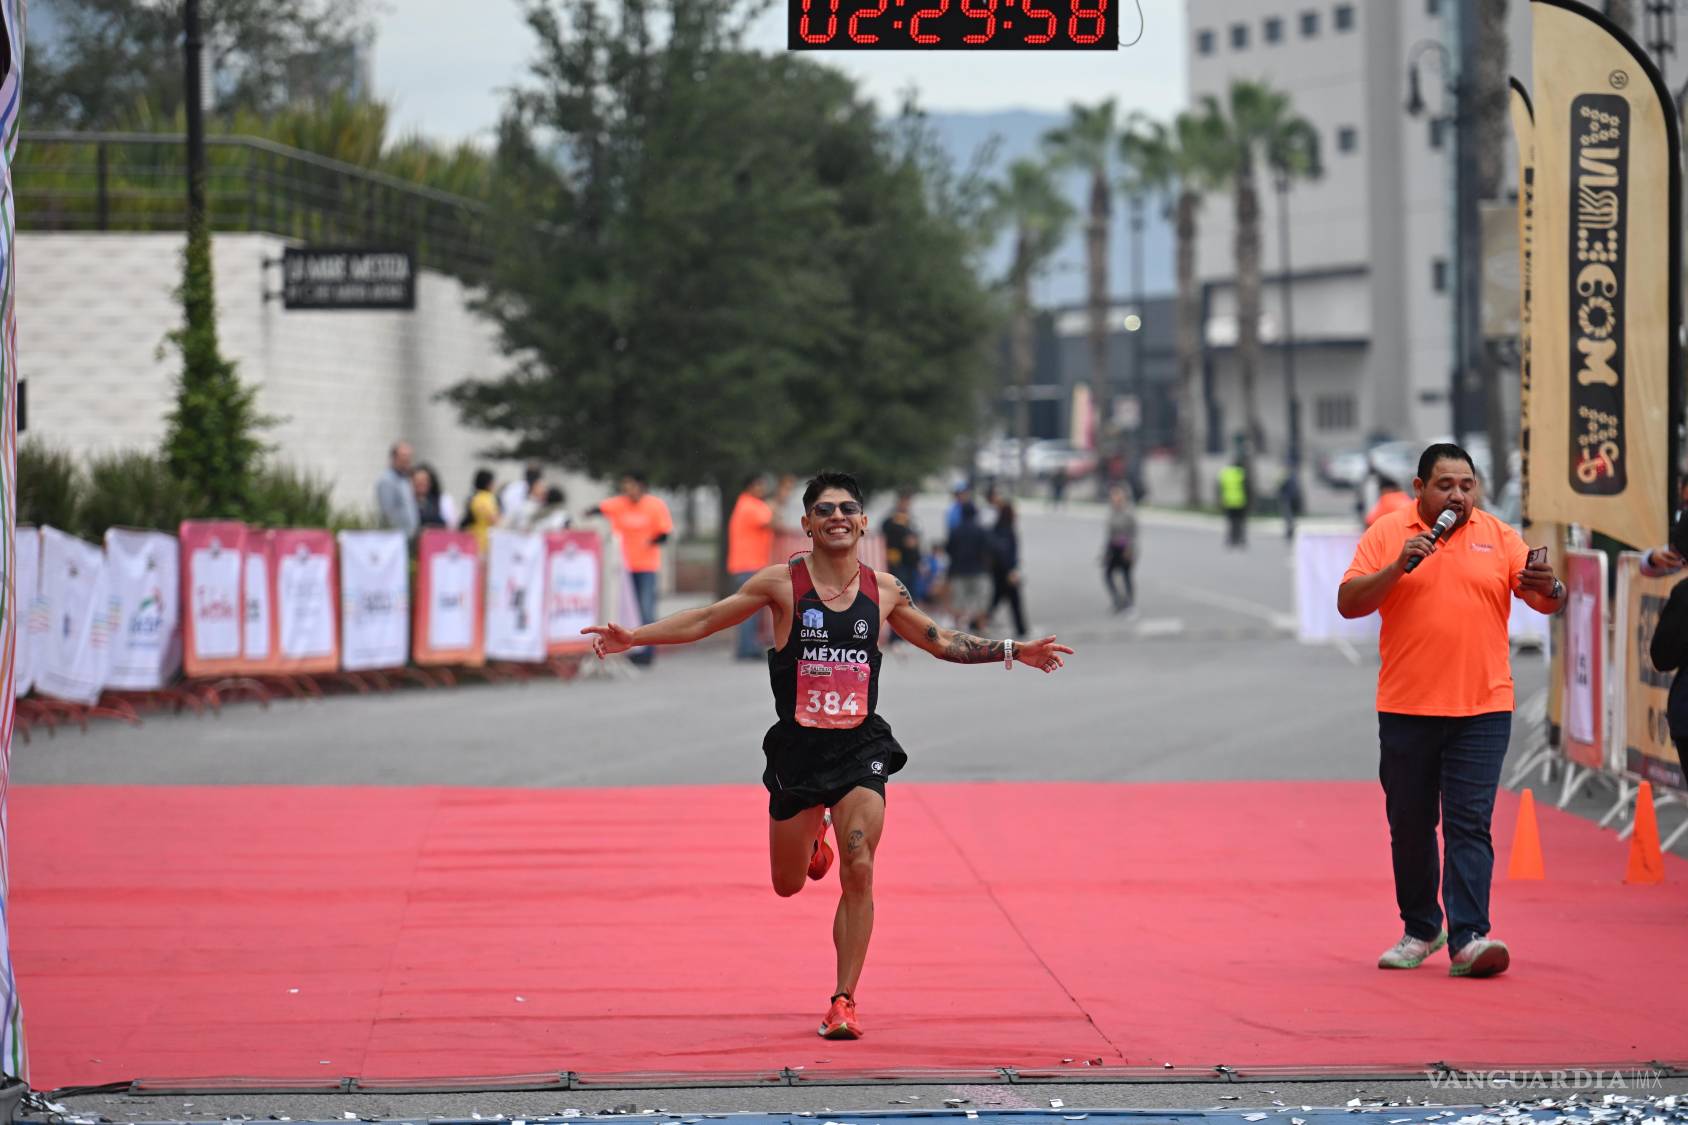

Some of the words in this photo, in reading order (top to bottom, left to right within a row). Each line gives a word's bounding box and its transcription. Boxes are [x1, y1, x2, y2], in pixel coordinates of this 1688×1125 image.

[799, 0, 1108, 44] 02:29:58
[800, 629, 828, 639] GIASA
[802, 644, 868, 664] MÉXICO
[806, 689, 859, 716] 384
